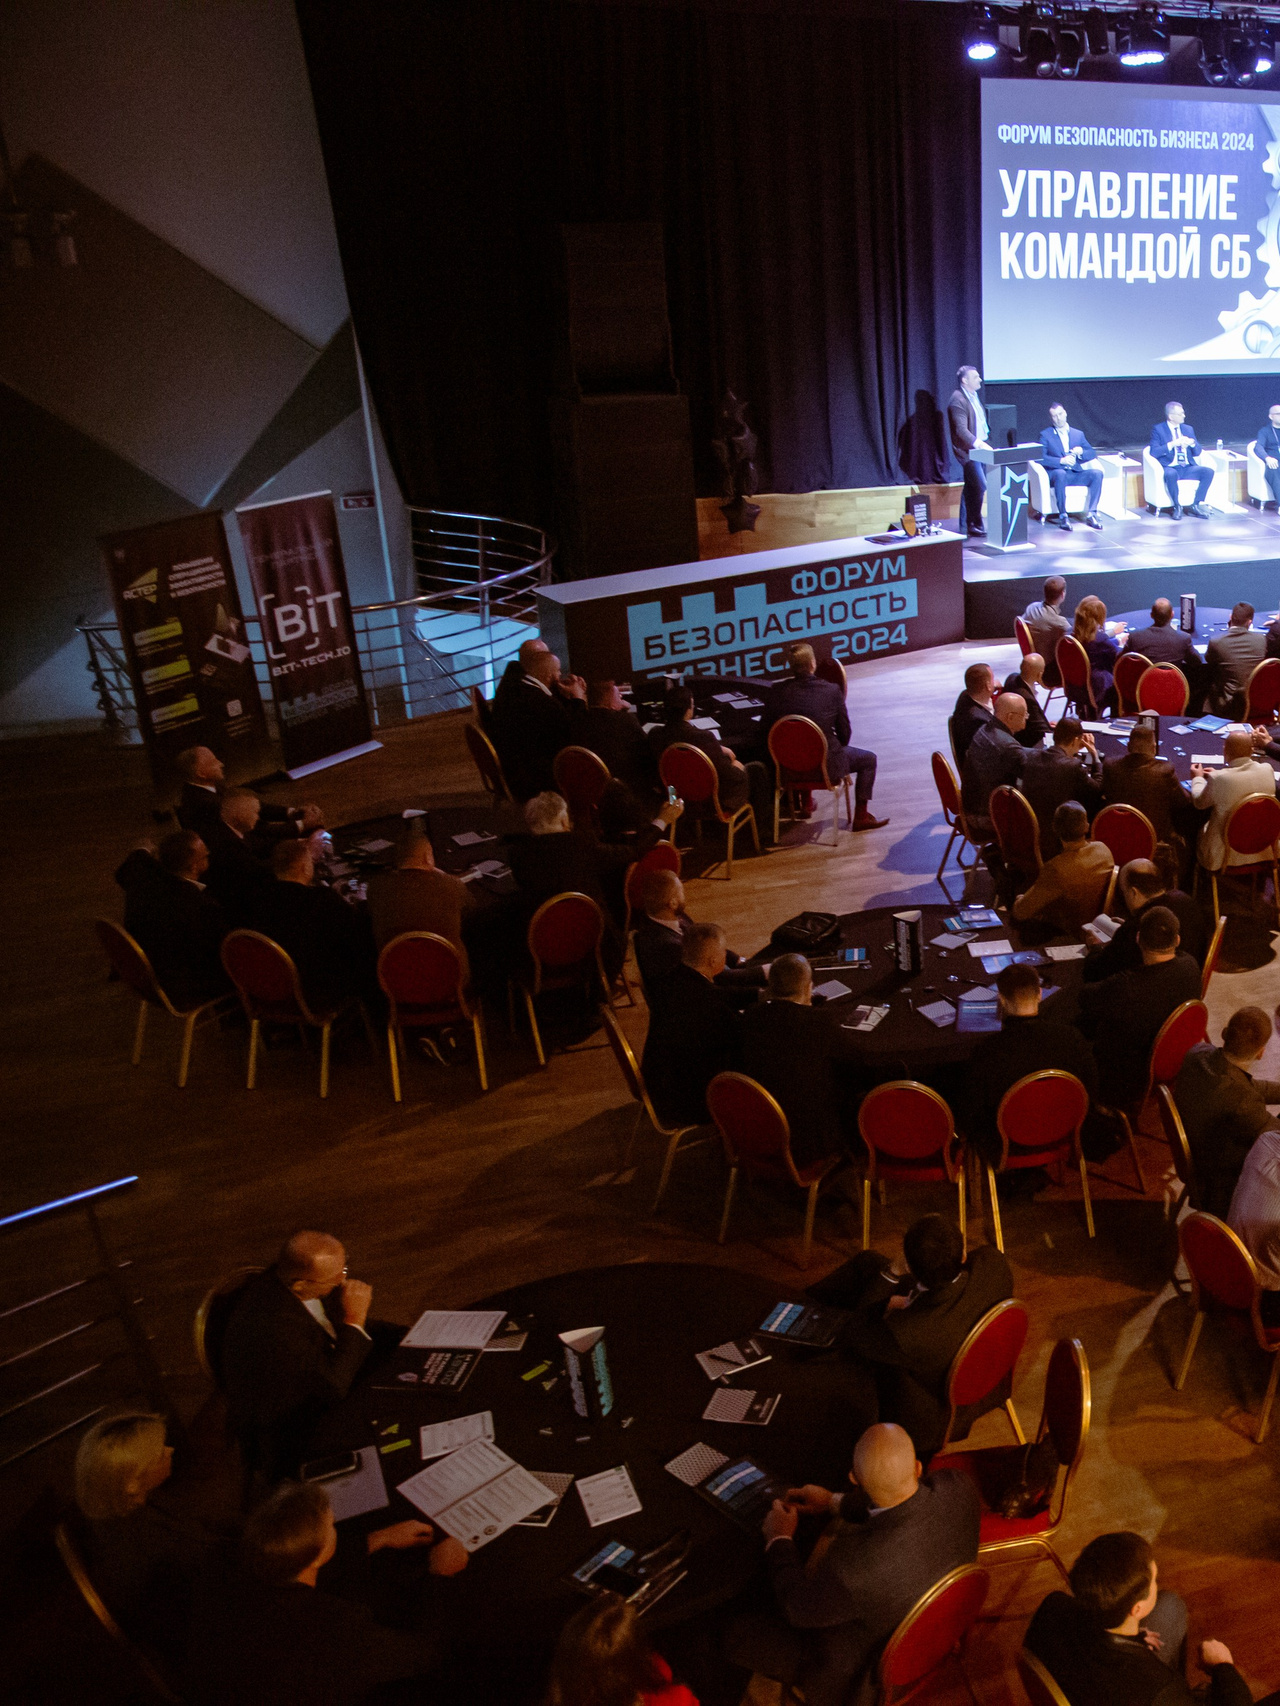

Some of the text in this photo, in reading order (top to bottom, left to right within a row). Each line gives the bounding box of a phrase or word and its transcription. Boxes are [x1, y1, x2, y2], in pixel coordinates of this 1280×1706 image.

[998, 124, 1254, 151] ФОРУМ БЕЗОПАСНОСТЬ БИЗНЕСА 2024
[998, 169, 1239, 220] УПРАВЛЕНИЕ
[1000, 226, 1251, 283] КОМАНДОЙ СБ
[791, 555, 907, 596] ФОРУМ
[273, 591, 341, 643] BiT
[644, 590, 907, 661] БЕЗОПАСНОСТЬ
[272, 645, 351, 677] BIT-TECH.IO
[831, 623, 909, 660] 2024
